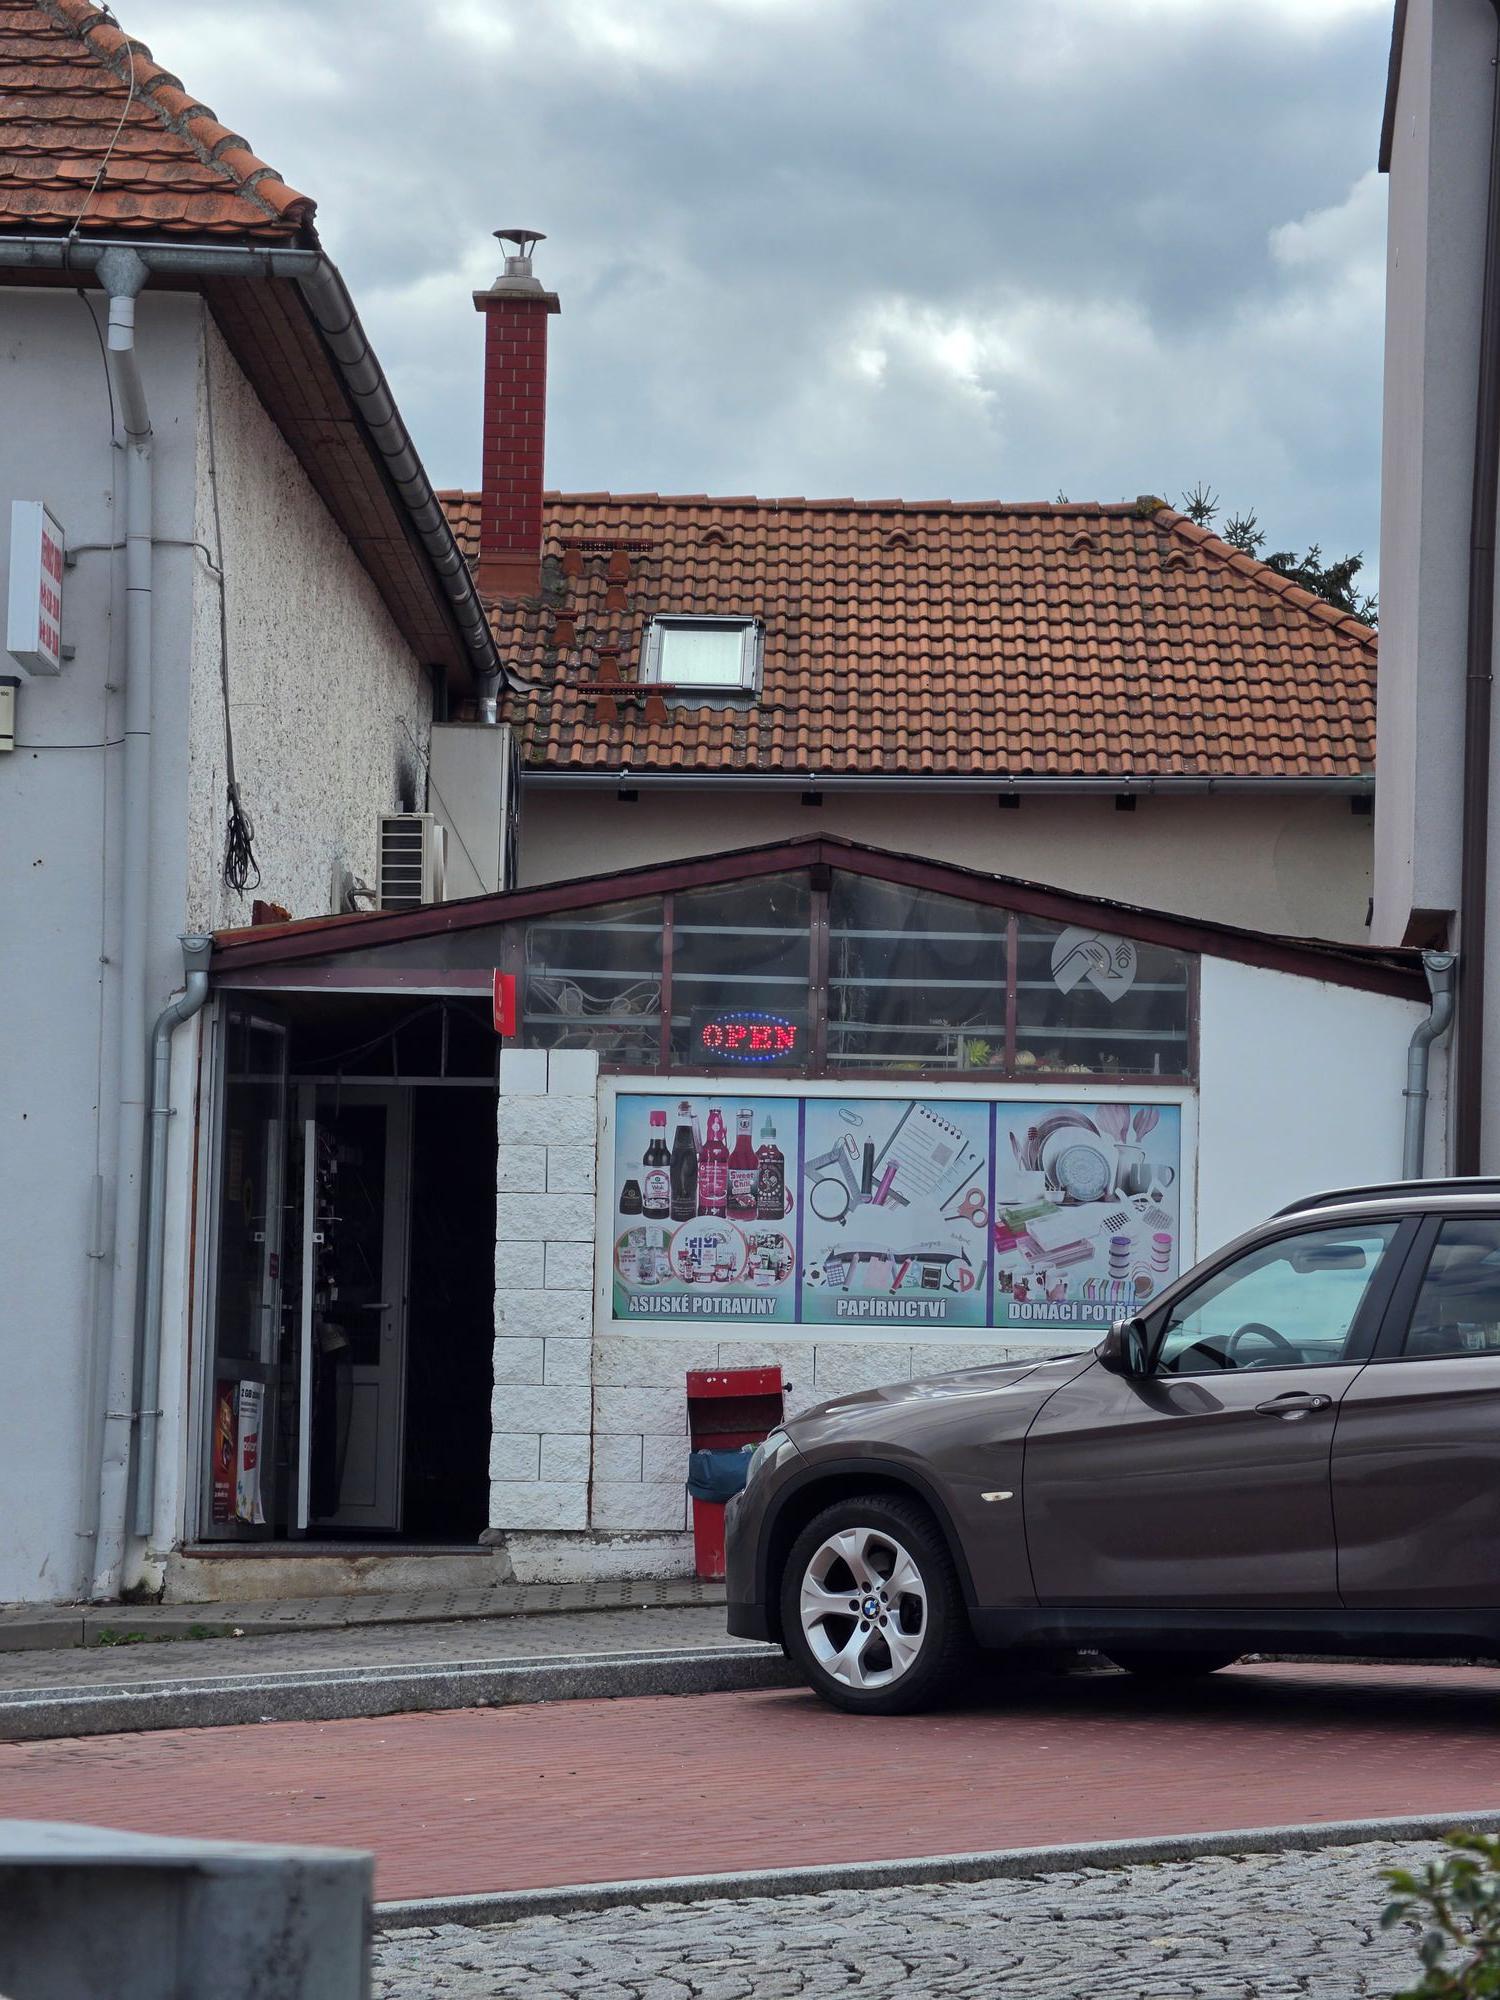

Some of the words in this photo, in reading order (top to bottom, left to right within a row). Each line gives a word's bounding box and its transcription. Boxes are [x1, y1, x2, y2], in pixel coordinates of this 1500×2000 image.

[702, 1024, 797, 1049] OPEN
[629, 1294, 689, 1313] ASIJSKÉ
[692, 1296, 776, 1314] POTRAVINY
[837, 1298, 947, 1318] PAPÍRNICTVÍ
[1008, 1302, 1078, 1320] DOMÁCÍ
